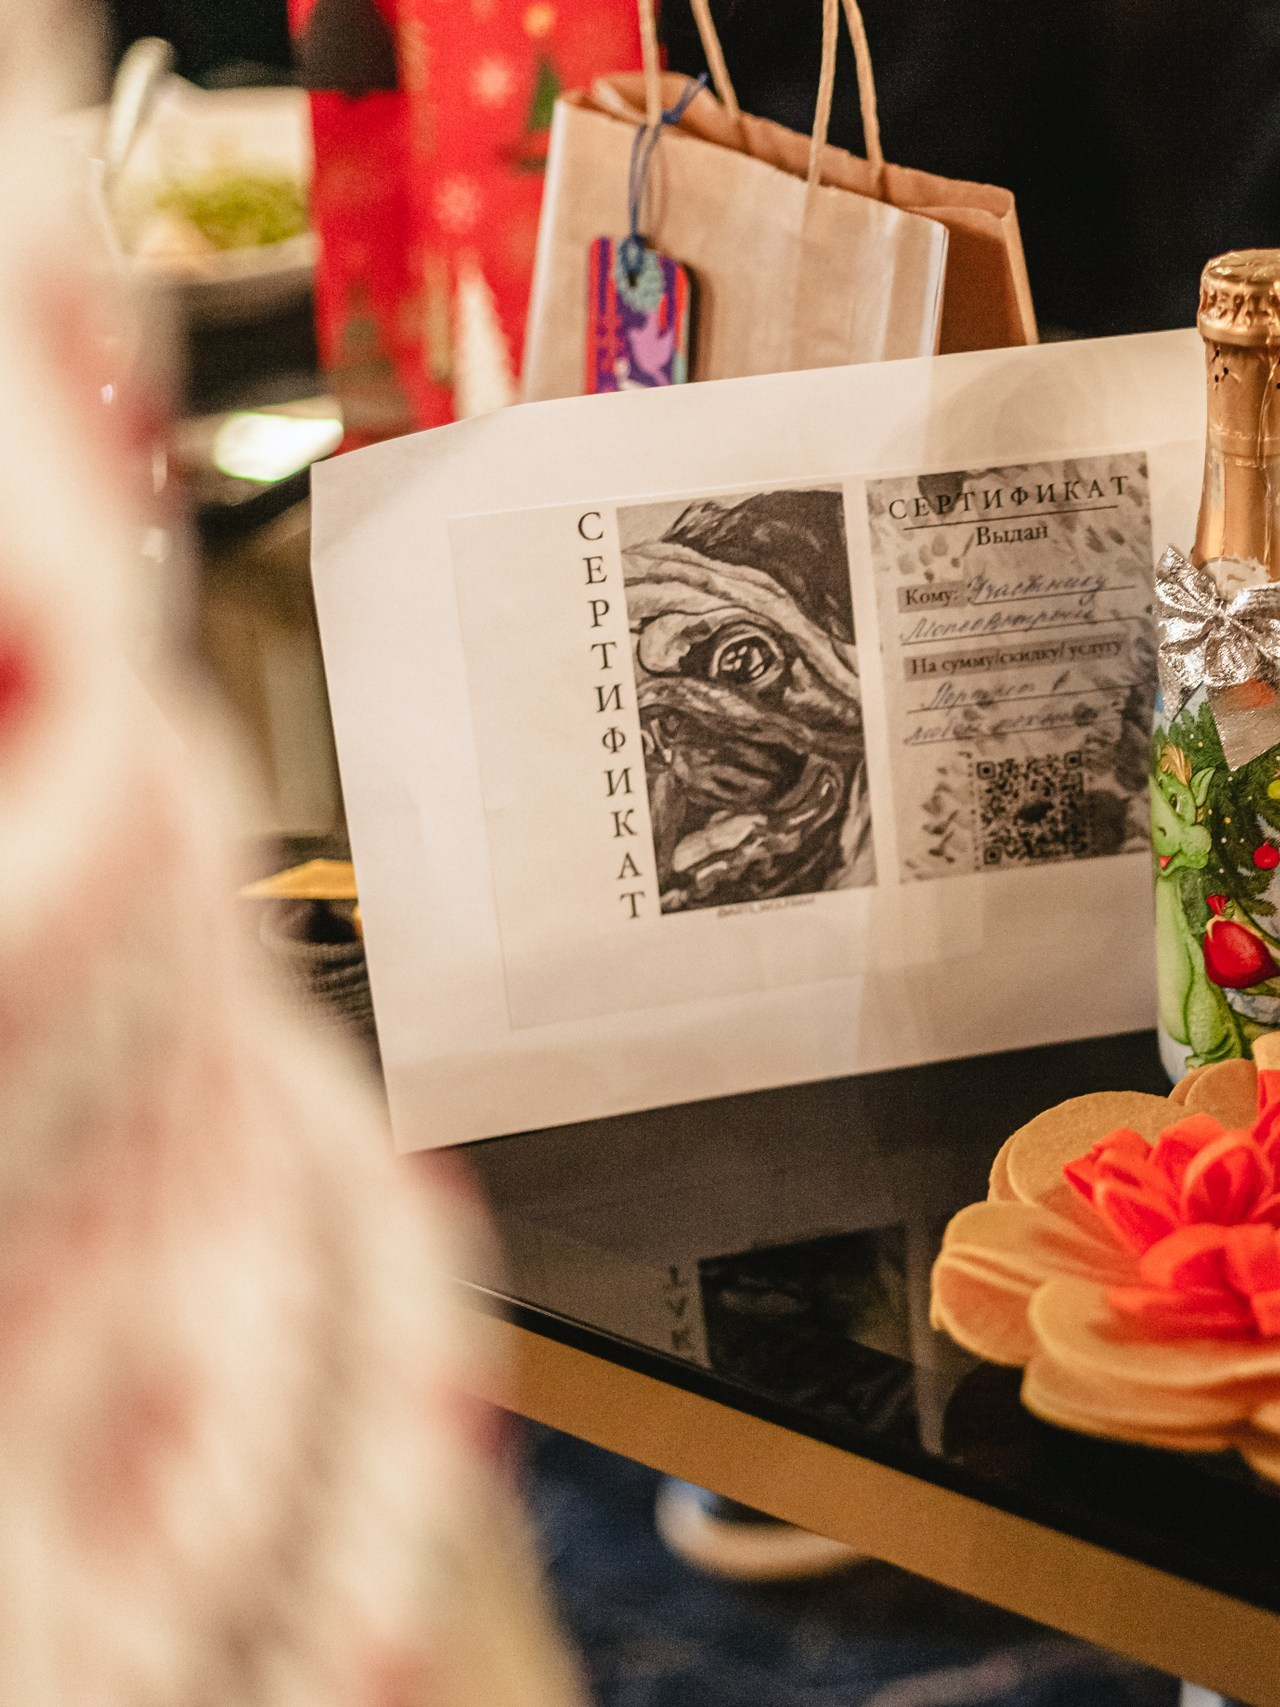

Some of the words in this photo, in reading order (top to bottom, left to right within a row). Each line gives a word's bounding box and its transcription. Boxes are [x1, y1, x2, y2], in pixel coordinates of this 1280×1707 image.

[889, 475, 1129, 520] СЕРТИФИКАТ
[976, 525, 1049, 546] Выдан
[905, 588, 959, 606] Кому:
[912, 657, 937, 675] На
[577, 511, 646, 919] СЕРТИФИКАТ
